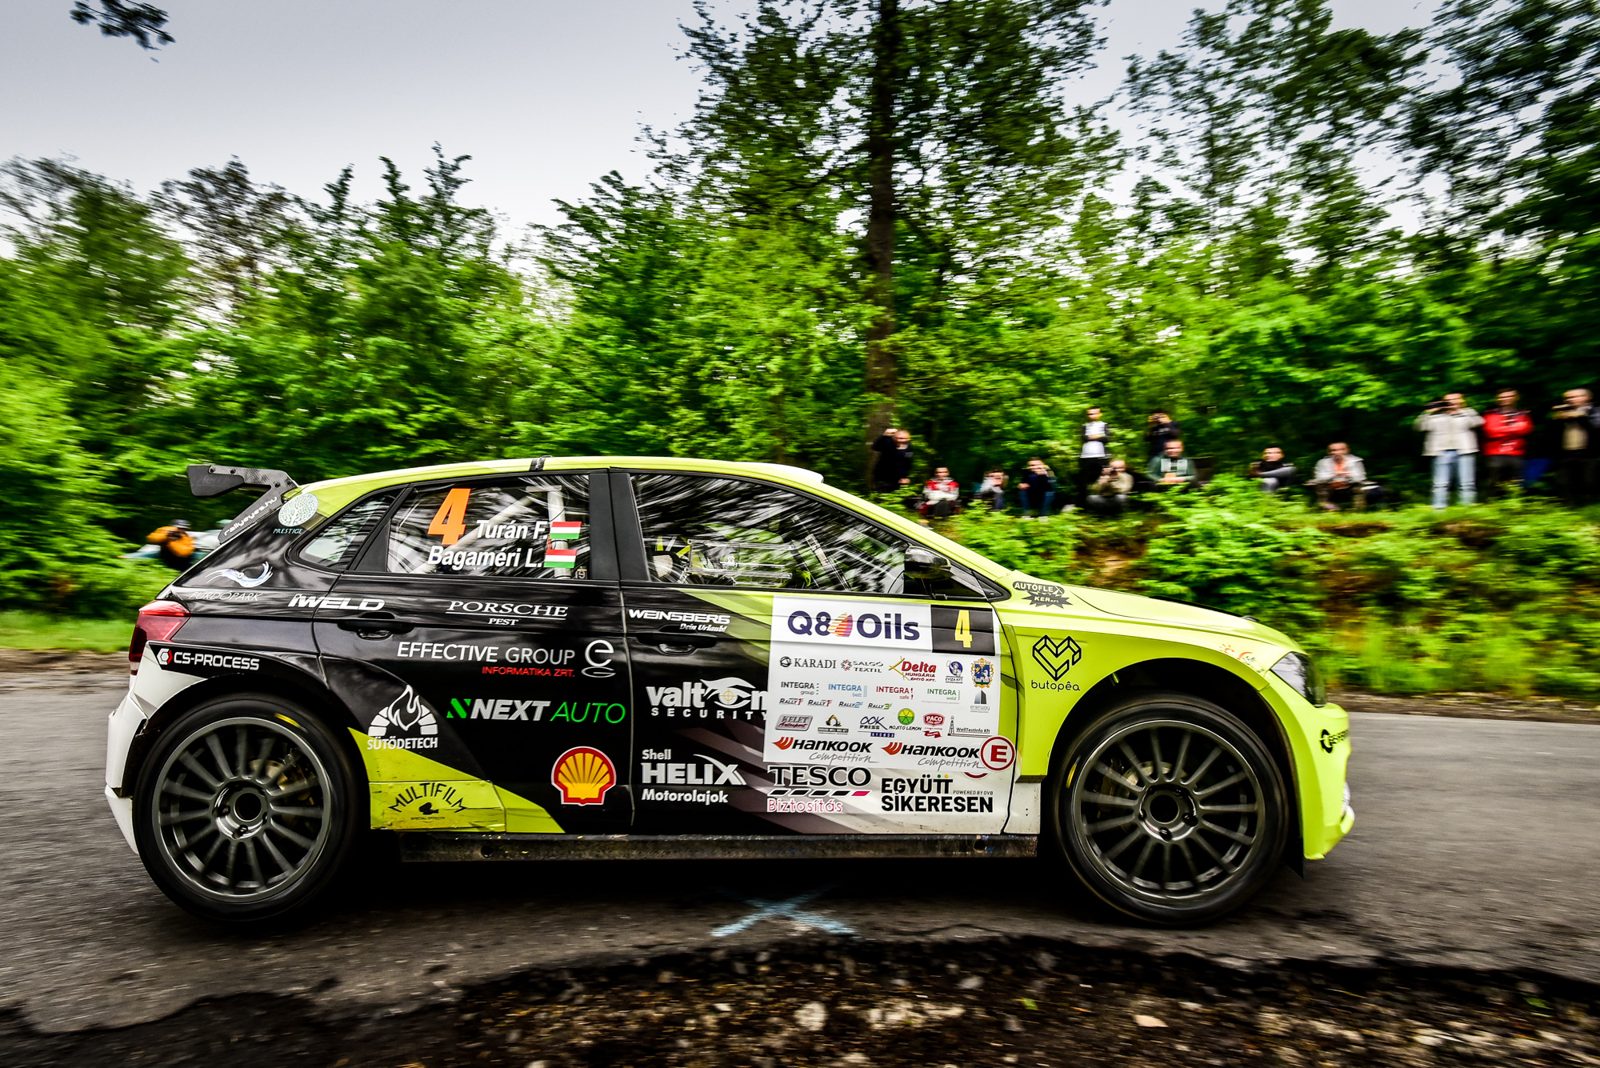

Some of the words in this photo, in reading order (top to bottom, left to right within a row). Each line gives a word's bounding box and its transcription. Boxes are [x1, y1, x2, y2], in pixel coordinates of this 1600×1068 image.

[428, 488, 471, 545] 4
[476, 519, 529, 539] Turán
[534, 522, 548, 539] F.
[427, 545, 519, 568] Bagaméri
[525, 549, 544, 567] L.
[449, 601, 568, 617] PORSCHE
[629, 609, 731, 624] WEINSBERG
[488, 617, 518, 626] PEST
[787, 610, 832, 636] Q8
[856, 613, 921, 640] Oils
[954, 610, 973, 648] 4
[173, 652, 260, 671] CS-PROCESS
[397, 641, 498, 663] EFFECTIVE
[506, 647, 575, 665] GROUP
[482, 666, 551, 677] INFORMATIKA
[553, 667, 575, 677] ZRT.
[793, 657, 837, 669] KARADI
[901, 661, 937, 673] Delta
[781, 681, 815, 689] INTEGRA
[828, 683, 862, 691] INTEGRA
[927, 688, 957, 696] INTEGRA
[1031, 679, 1080, 692] butopêa
[471, 700, 550, 721] NEXT
[549, 702, 625, 724] AUTO
[642, 749, 672, 760] Shell
[990, 745, 1008, 762] E
[641, 754, 747, 785] HELIX
[768, 766, 872, 788] TESCO
[881, 774, 953, 794] EGYÜTT
[388, 782, 467, 813] MULTIFILM
[641, 789, 729, 806] Motorolajok
[766, 798, 844, 814] Biztosítás
[881, 793, 993, 813] SIKERESEN
